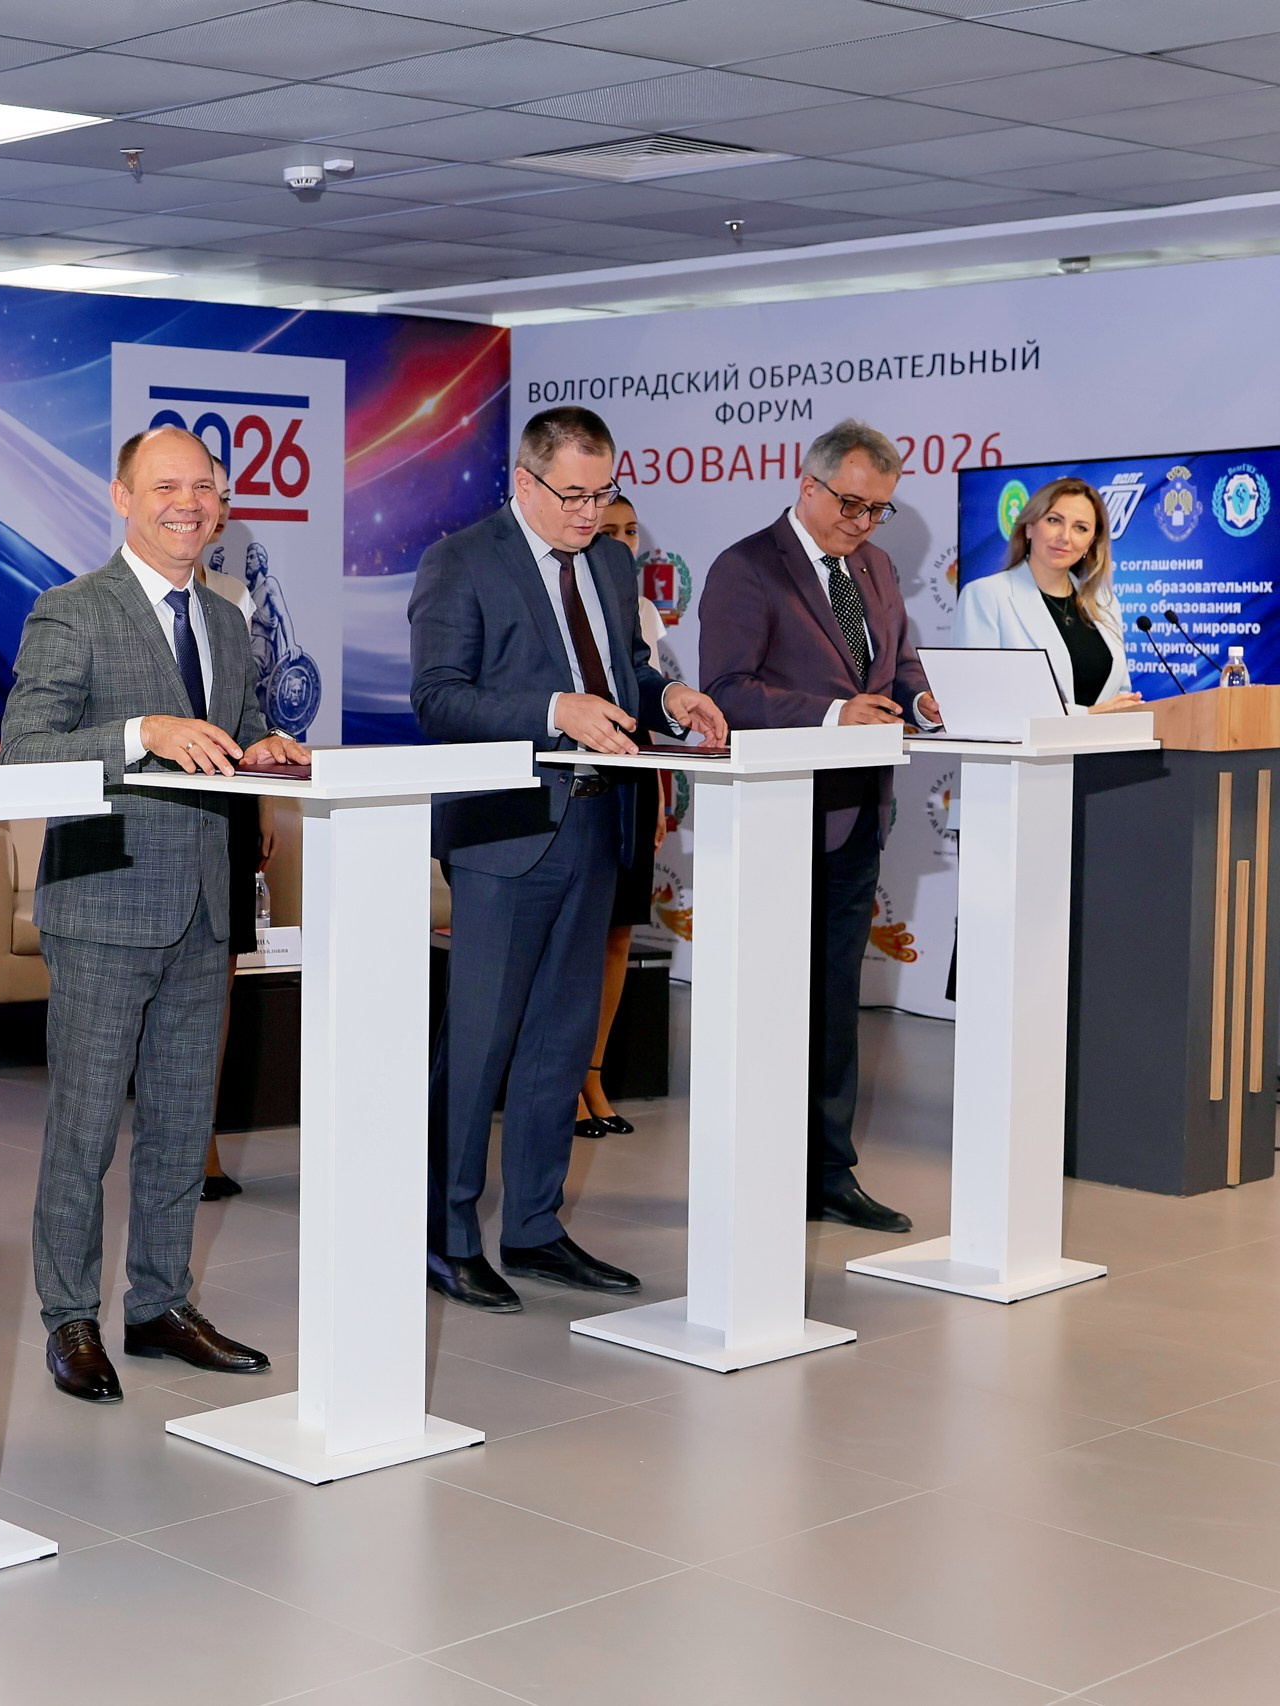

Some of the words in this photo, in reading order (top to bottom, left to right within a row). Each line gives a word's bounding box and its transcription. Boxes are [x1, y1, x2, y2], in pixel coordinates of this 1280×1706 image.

[528, 363, 739, 403] ВОЛГОГРАДСКИЙ
[749, 339, 1041, 390] ОБРАЗОВАТЕЛЬНЫЙ
[715, 398, 813, 426] ФОРУМ
[149, 409, 310, 498] 026
[615, 442, 803, 485] АЗОВАН
[896, 432, 1003, 475] 2026
[1120, 558, 1204, 571] соглашения
[1146, 579, 1273, 597] образовательных
[1192, 621, 1261, 637] мирового
